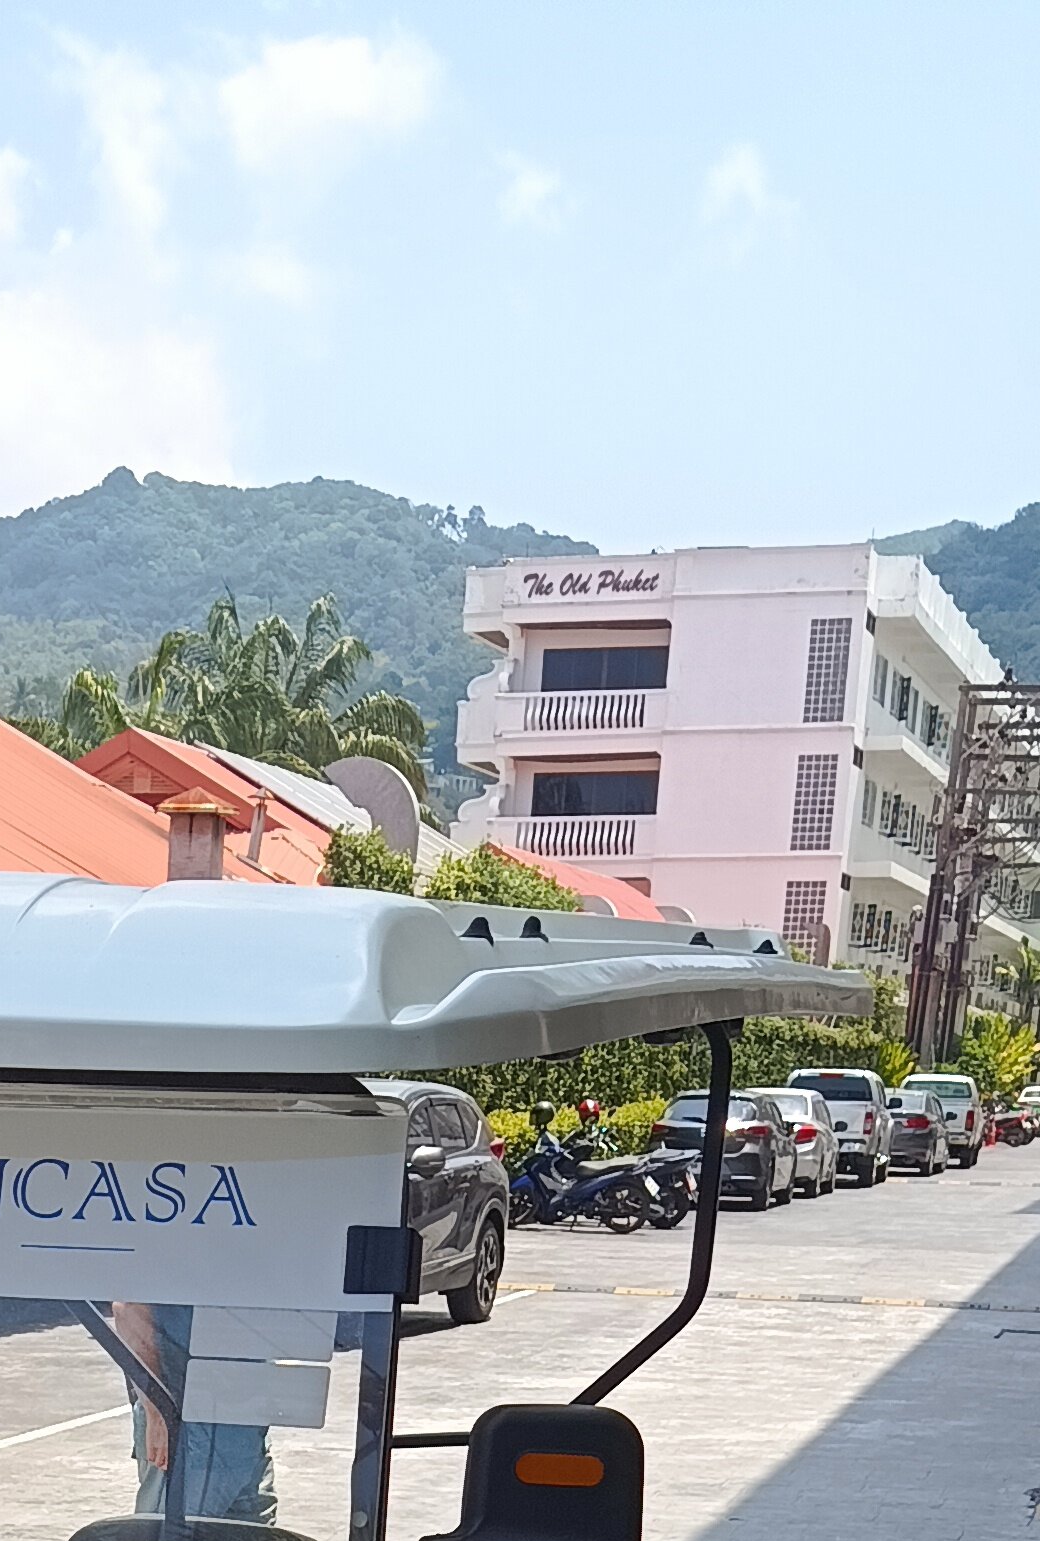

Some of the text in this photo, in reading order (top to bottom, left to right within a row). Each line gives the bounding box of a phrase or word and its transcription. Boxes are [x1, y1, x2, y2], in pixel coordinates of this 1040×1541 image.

[523, 567, 660, 599] The Old Phuket
